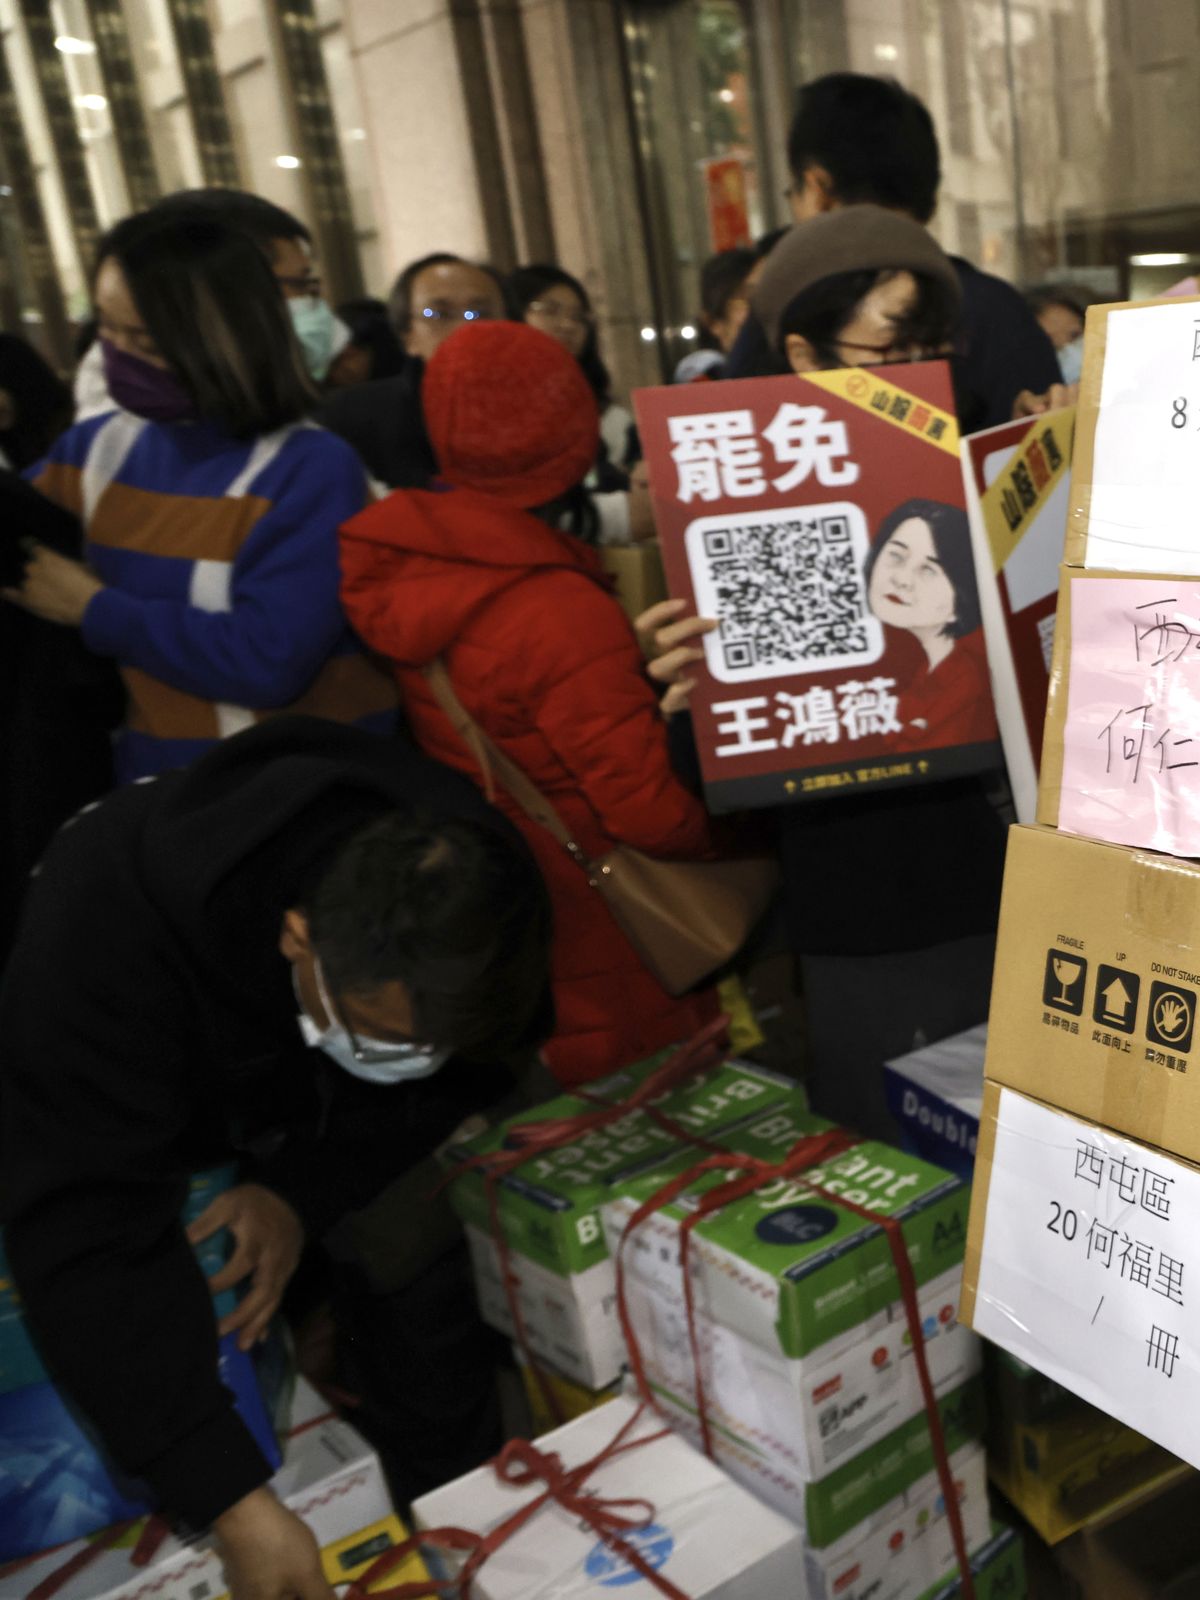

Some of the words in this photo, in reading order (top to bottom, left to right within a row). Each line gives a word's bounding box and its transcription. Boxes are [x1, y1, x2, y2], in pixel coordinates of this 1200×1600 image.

[1171, 396, 1188, 429] 8
[667, 402, 861, 503] 罷免
[711, 677, 904, 758] 王鴻薇
[1056, 934, 1085, 950] FRAGILE
[1115, 952, 1127, 962] UP
[1151, 962, 1161, 974] DO
[1162, 964, 1178, 977] NOT
[1091, 1029, 1132, 1054] 此面向上
[1074, 1138, 1176, 1221] 西屯區
[1046, 1201, 1078, 1242] 20
[1085, 1217, 1184, 1307] 何福里
[1146, 1324, 1180, 1379] 冊
